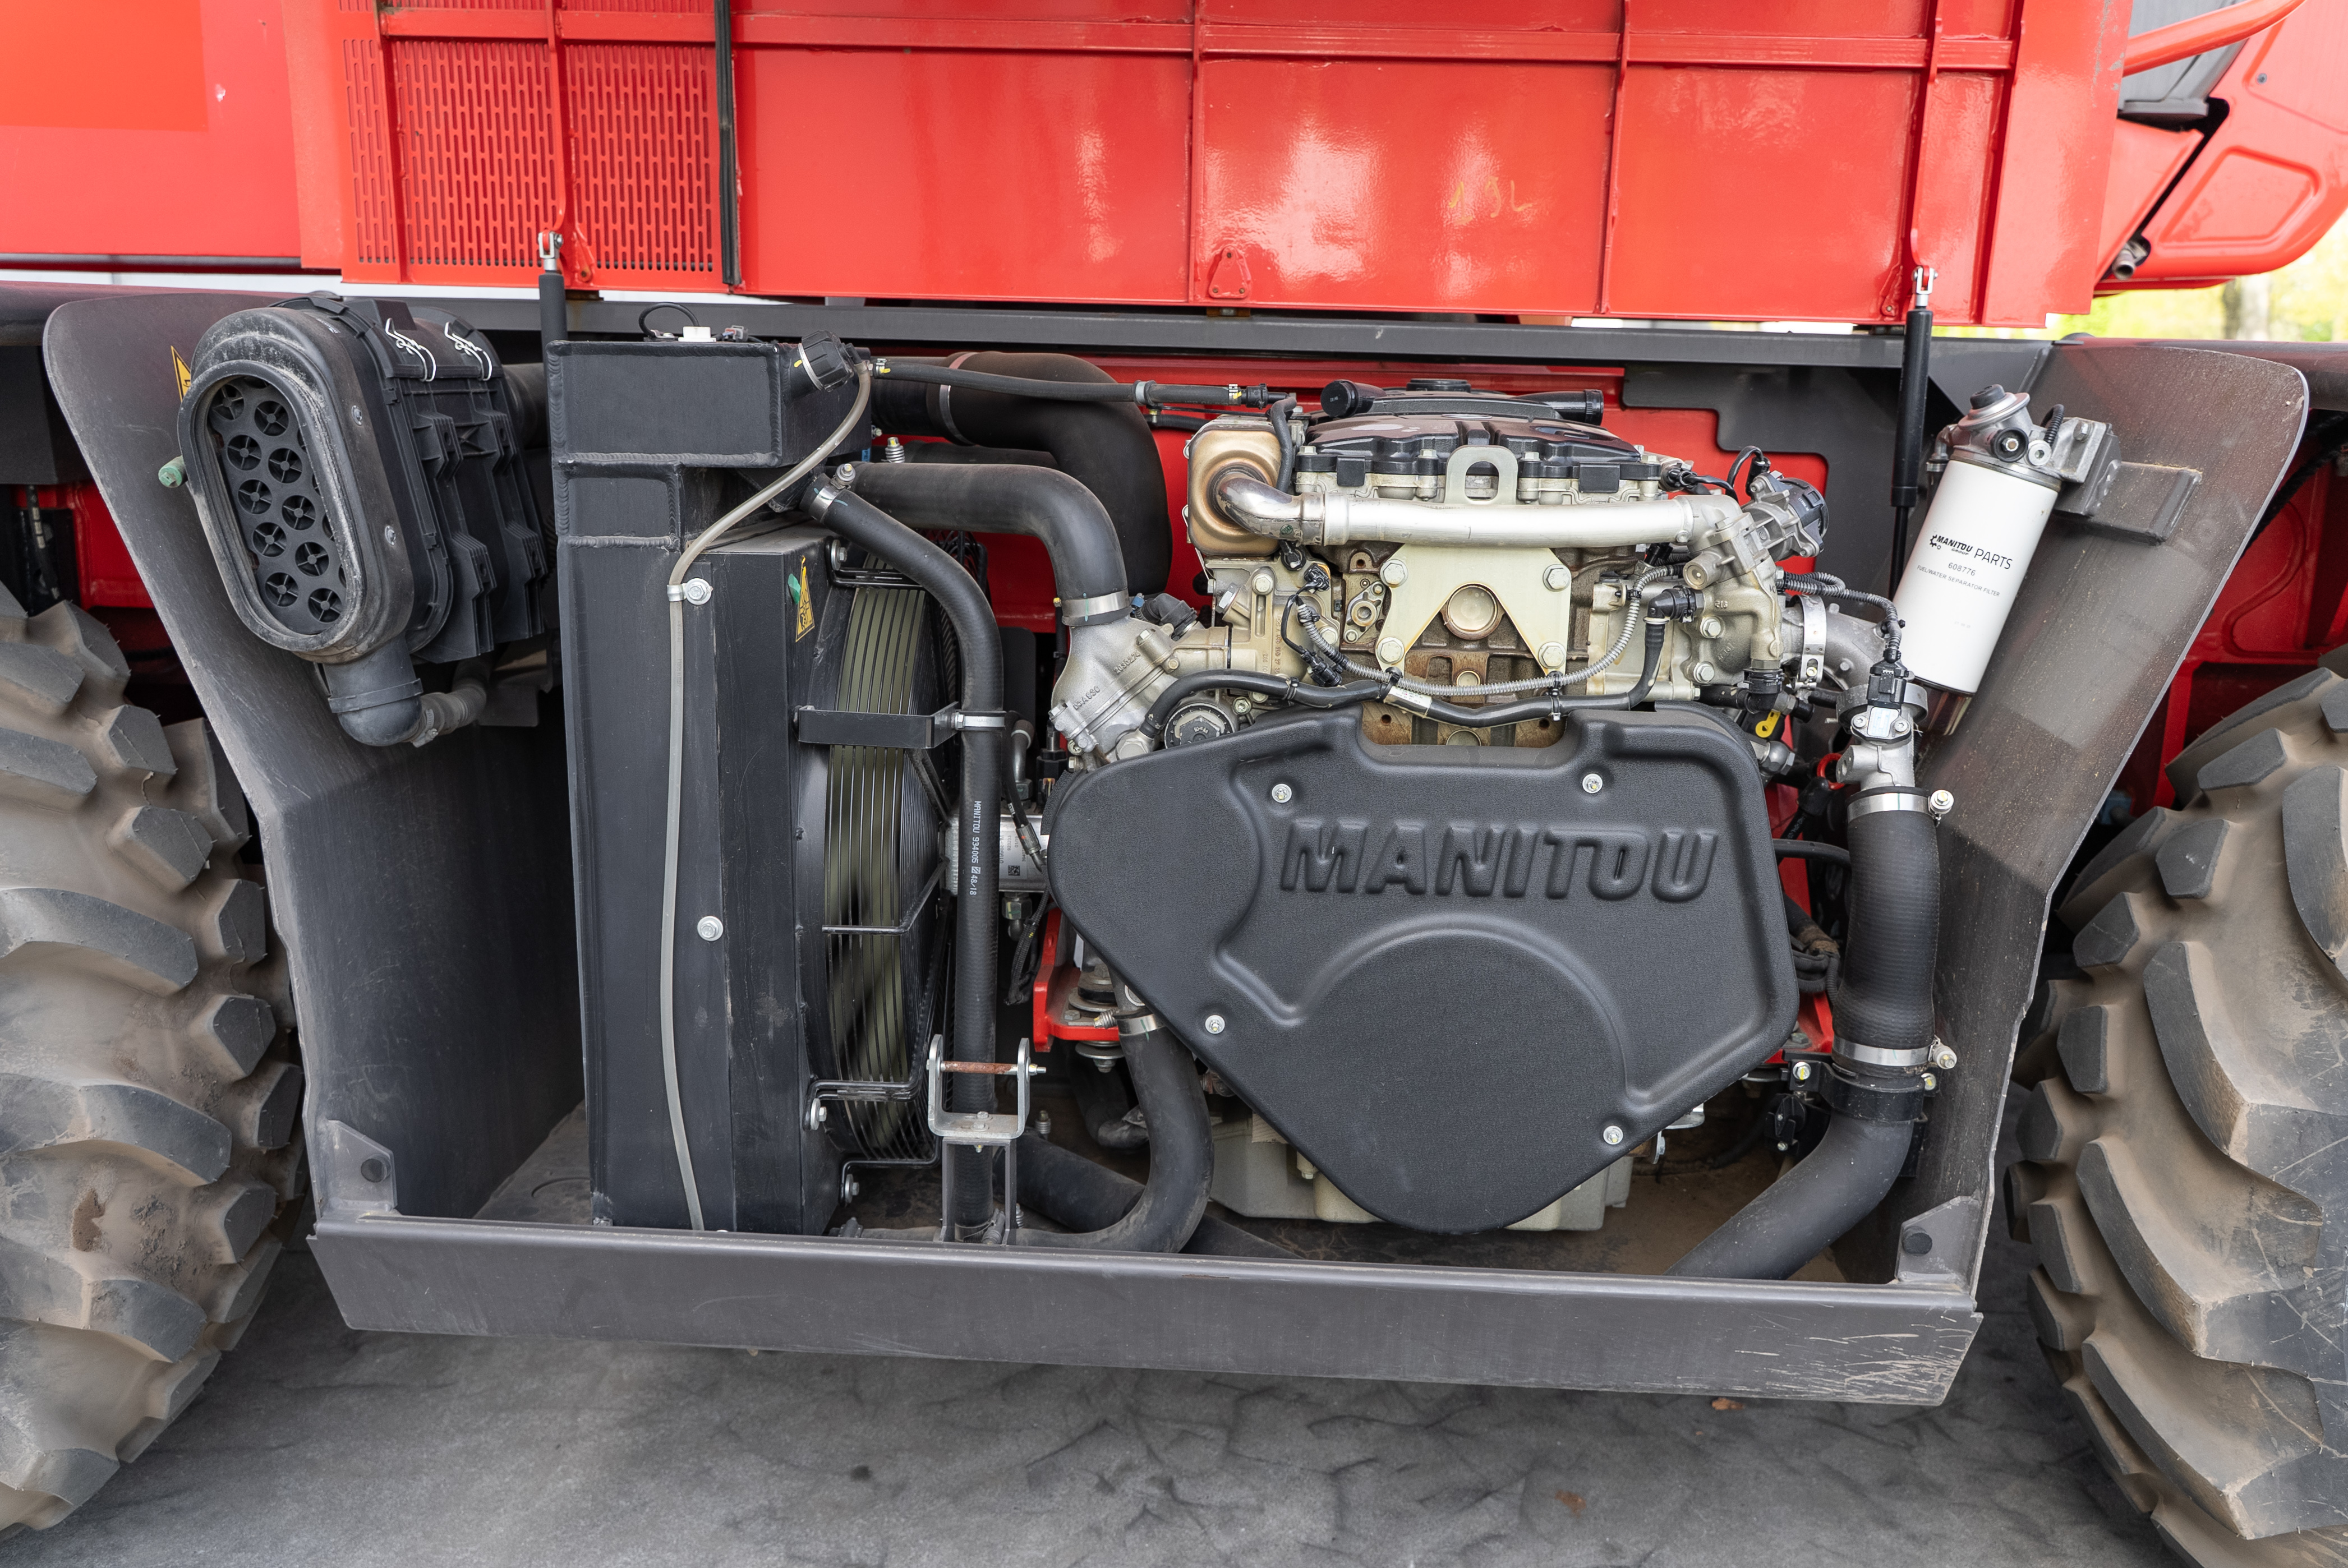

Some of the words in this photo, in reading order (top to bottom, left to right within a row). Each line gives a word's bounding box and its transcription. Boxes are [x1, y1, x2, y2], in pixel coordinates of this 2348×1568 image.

[1936, 535, 1973, 552] MANITOU
[1974, 548, 2013, 570] PARTS
[1948, 562, 1976, 577] 608776
[1948, 576, 1983, 591] SEPARATOR
[1983, 588, 2000, 597] FILTER
[973, 800, 982, 833] MANITOU
[972, 837, 980, 864] 934005
[1281, 820, 1718, 902] MANITOU
[969, 875, 978, 895] 48/18
